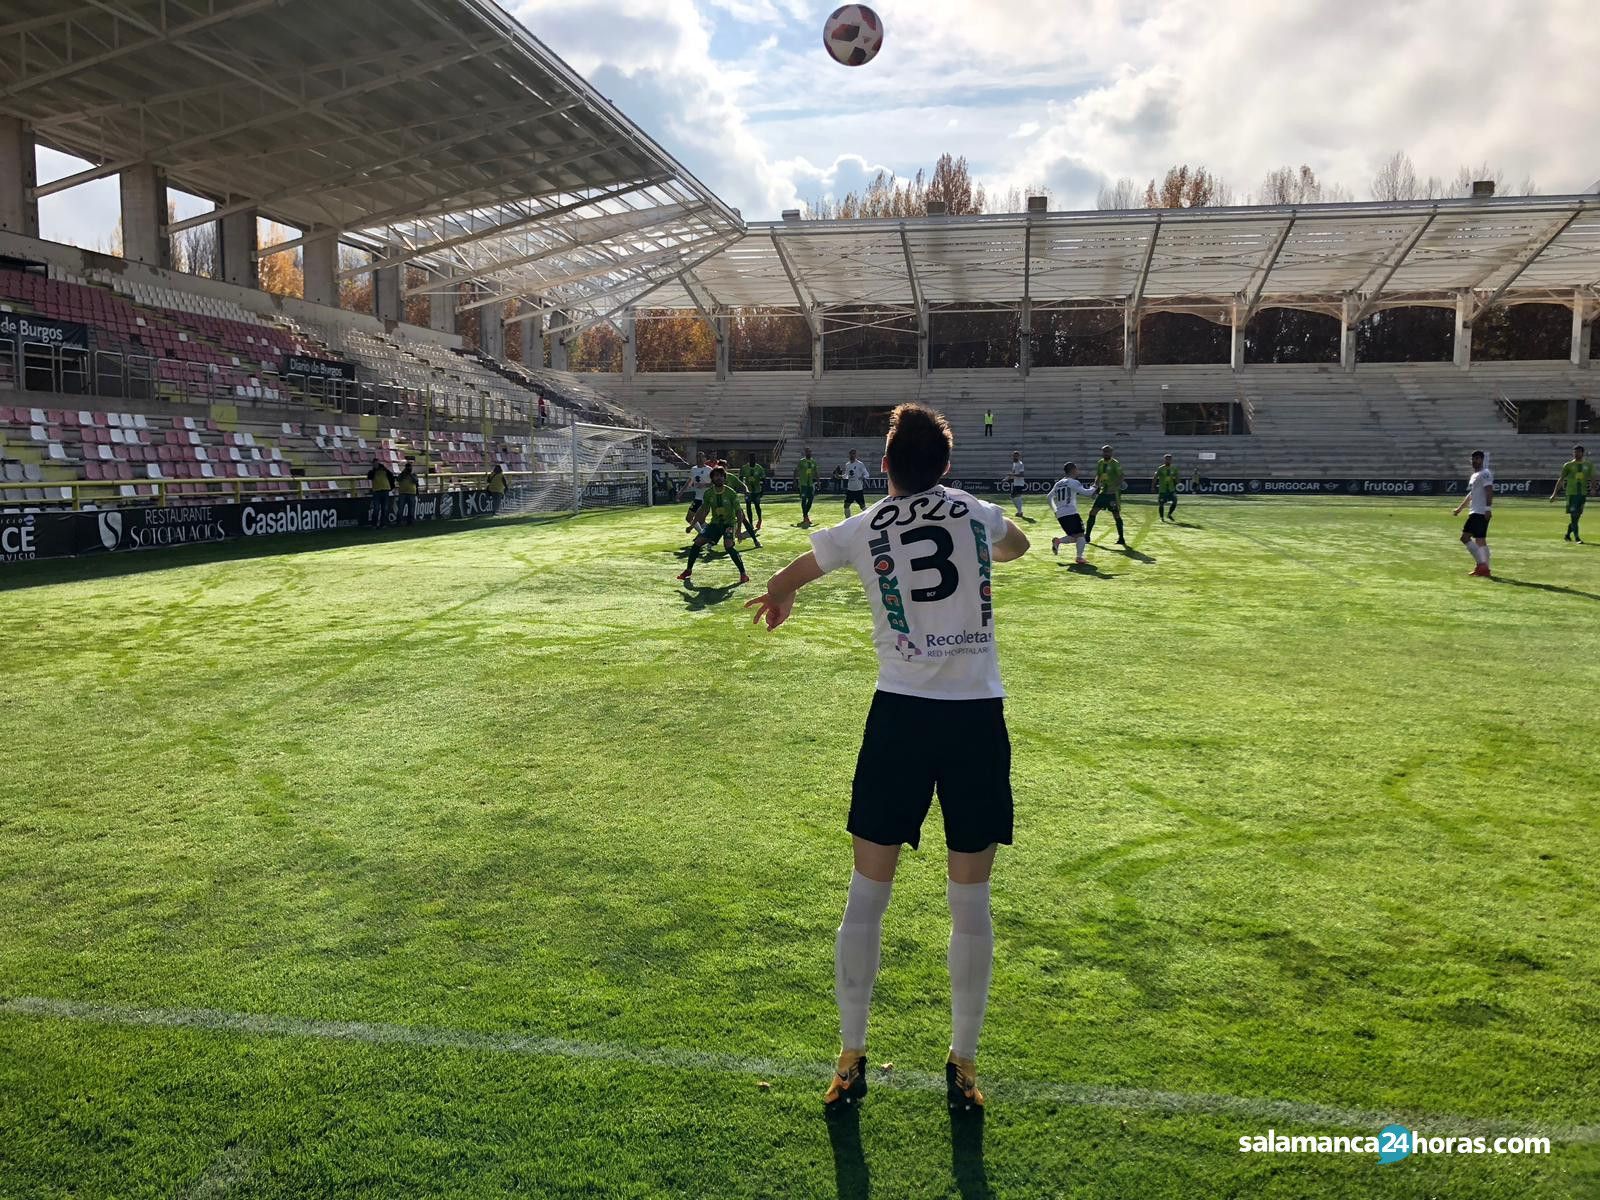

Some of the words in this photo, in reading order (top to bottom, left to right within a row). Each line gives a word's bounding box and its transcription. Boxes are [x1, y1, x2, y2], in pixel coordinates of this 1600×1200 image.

[20, 319, 63, 343] Burgos
[290, 358, 310, 372] Diario
[310, 360, 320, 374] de
[320, 363, 343, 377] Burgos
[1264, 482, 1320, 491] BURGOCAR
[1364, 480, 1414, 492] frutopía
[145, 506, 212, 525] RESTAURANTE
[241, 503, 338, 536] Casablanca
[870, 497, 970, 530] OSLO
[129, 519, 225, 551] SOTOPALACIOS
[899, 525, 960, 603] 3
[927, 650, 943, 658] RED
